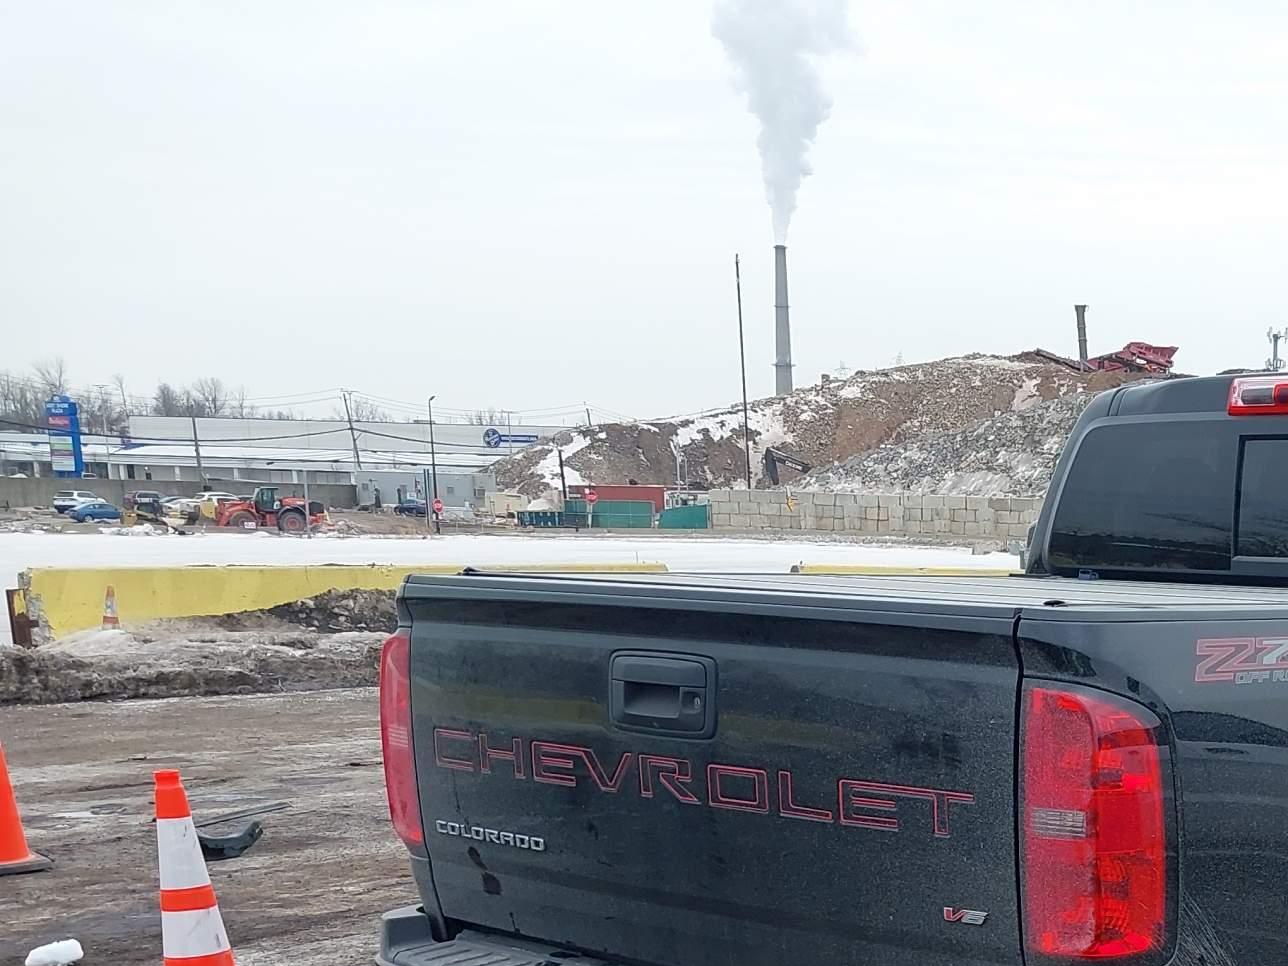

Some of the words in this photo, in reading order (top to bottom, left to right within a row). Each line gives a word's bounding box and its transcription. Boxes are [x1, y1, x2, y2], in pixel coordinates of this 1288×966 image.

[1235, 671, 1270, 684] OFF
[433, 727, 976, 839] CHEVROLET
[435, 819, 545, 852] COLORADO
[943, 906, 989, 926] V6
